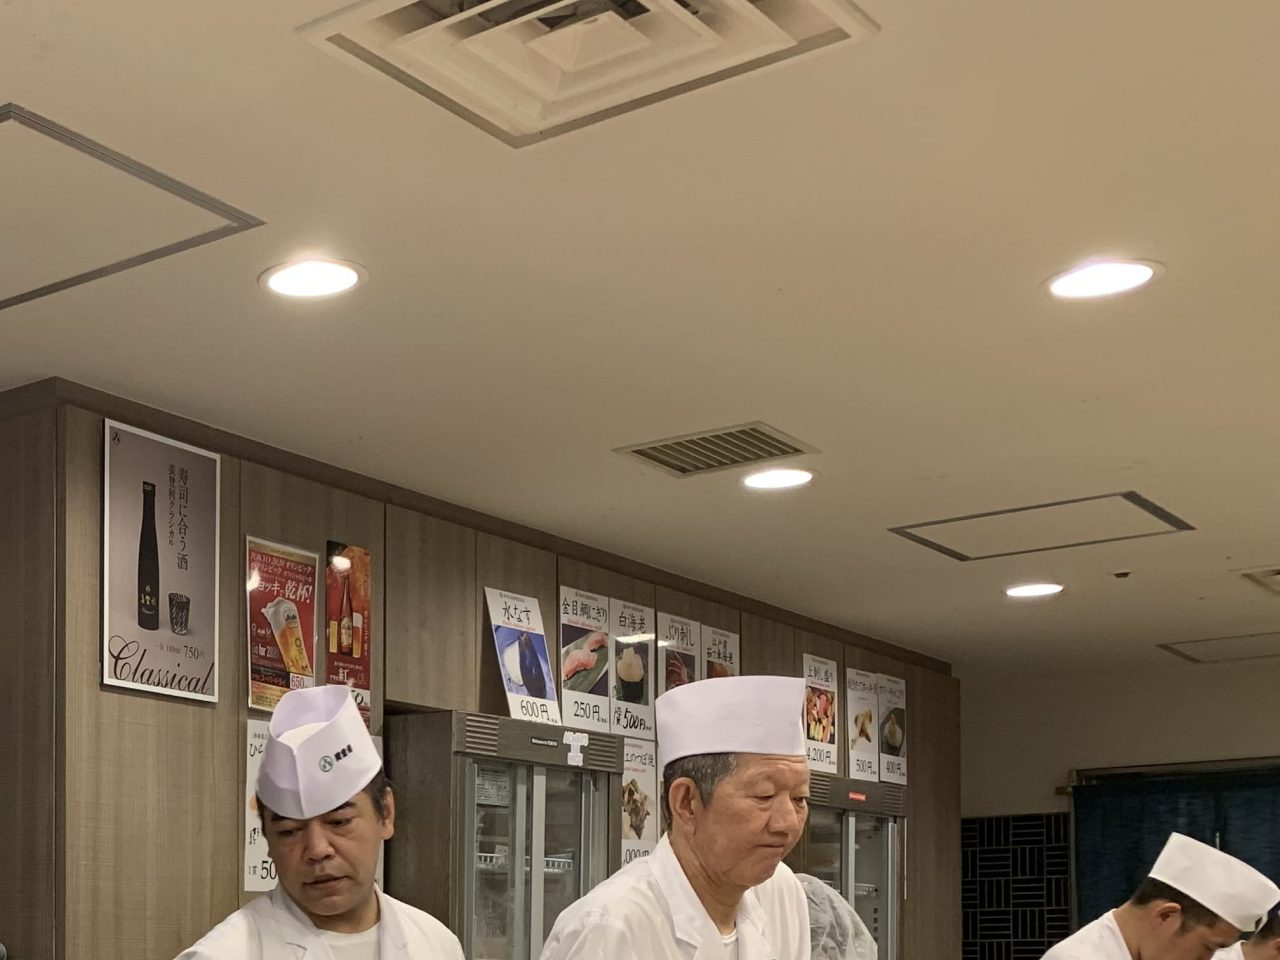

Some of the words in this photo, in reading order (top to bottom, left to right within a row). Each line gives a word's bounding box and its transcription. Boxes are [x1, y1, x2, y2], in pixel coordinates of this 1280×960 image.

[177, 466, 189, 571] 寿司に合う酒
[108, 634, 215, 694] Classical
[520, 699, 550, 721] 600円
[573, 700, 600, 723] 250円
